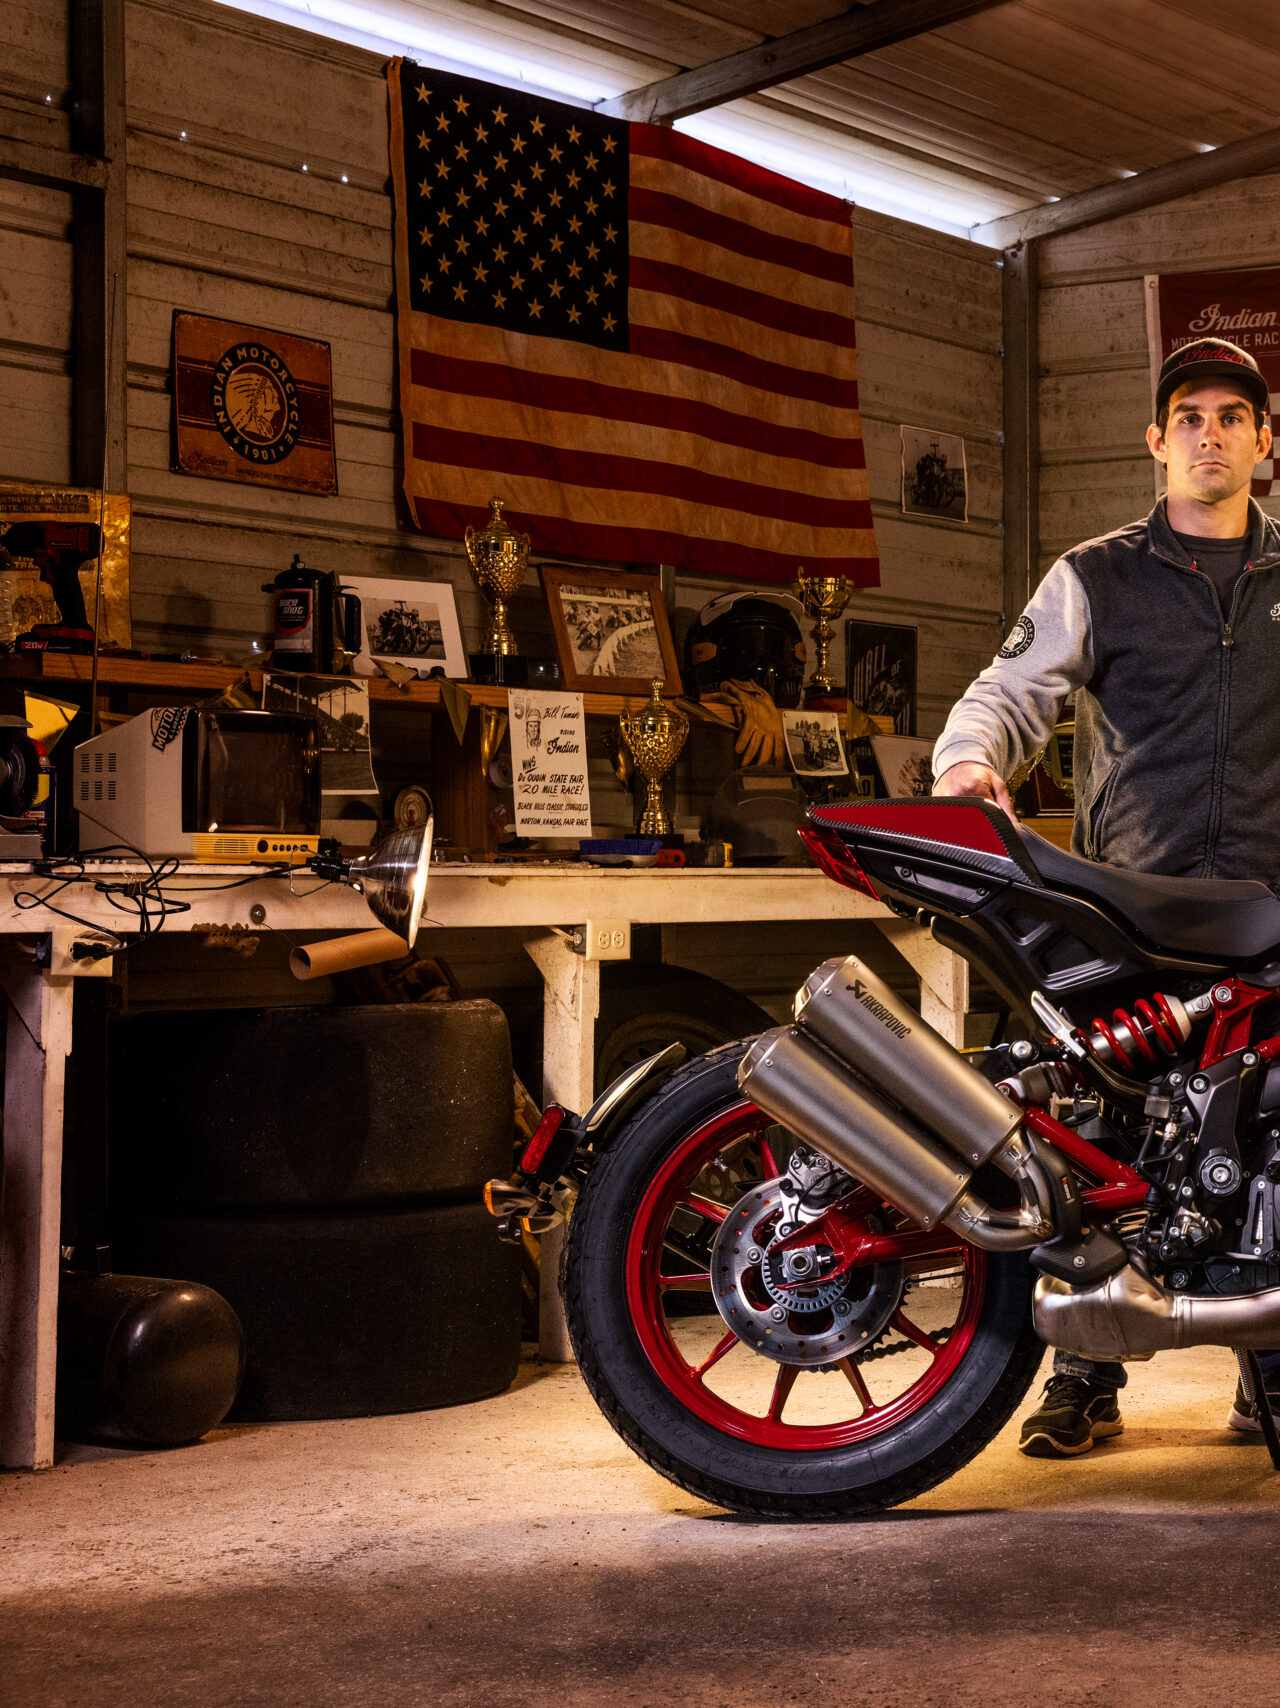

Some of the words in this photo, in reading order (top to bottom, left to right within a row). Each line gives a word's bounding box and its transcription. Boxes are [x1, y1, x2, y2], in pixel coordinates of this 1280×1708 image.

[1188, 303, 1278, 333] Indian
[1178, 343, 1245, 367] Indian
[213, 357, 233, 433] INDIAN
[236, 346, 299, 445] MOTORCYCLE
[245, 444, 277, 460] 1901
[542, 705, 561, 720] Bill
[547, 737, 580, 755] Indian
[550, 774, 568, 784] STATE
[569, 774, 584, 784] FAIR
[522, 784, 539, 794] 20
[542, 785, 558, 794] MILE
[560, 784, 584, 796] RACE!
[518, 802, 533, 811] BLACK
